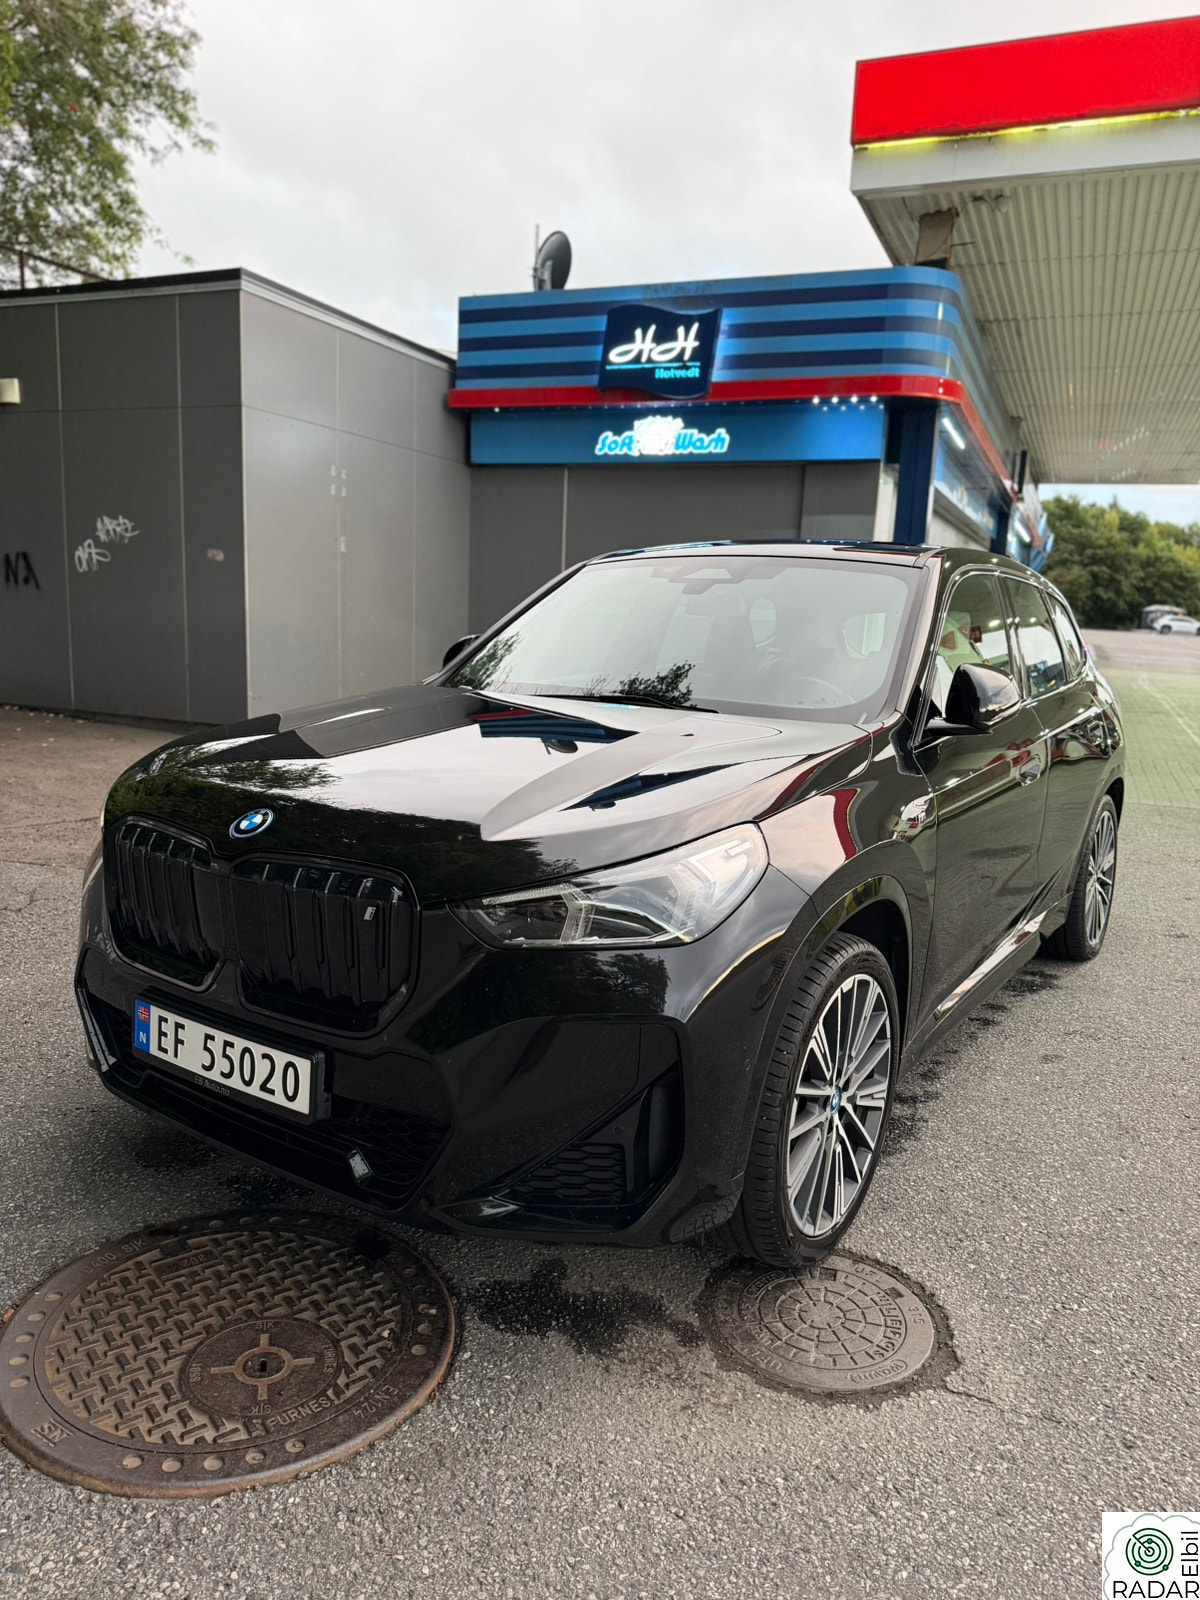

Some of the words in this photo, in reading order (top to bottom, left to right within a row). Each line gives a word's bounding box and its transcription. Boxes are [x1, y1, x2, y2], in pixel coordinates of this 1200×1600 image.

[655, 368, 700, 379] Hotvedt
[672, 429, 729, 453] Wash
[139, 1031, 147, 1044] N
[158, 1014, 186, 1059] EF
[201, 1032, 300, 1103] 55020
[908, 1305, 926, 1325] 315
[265, 1396, 332, 1431] FURNES
